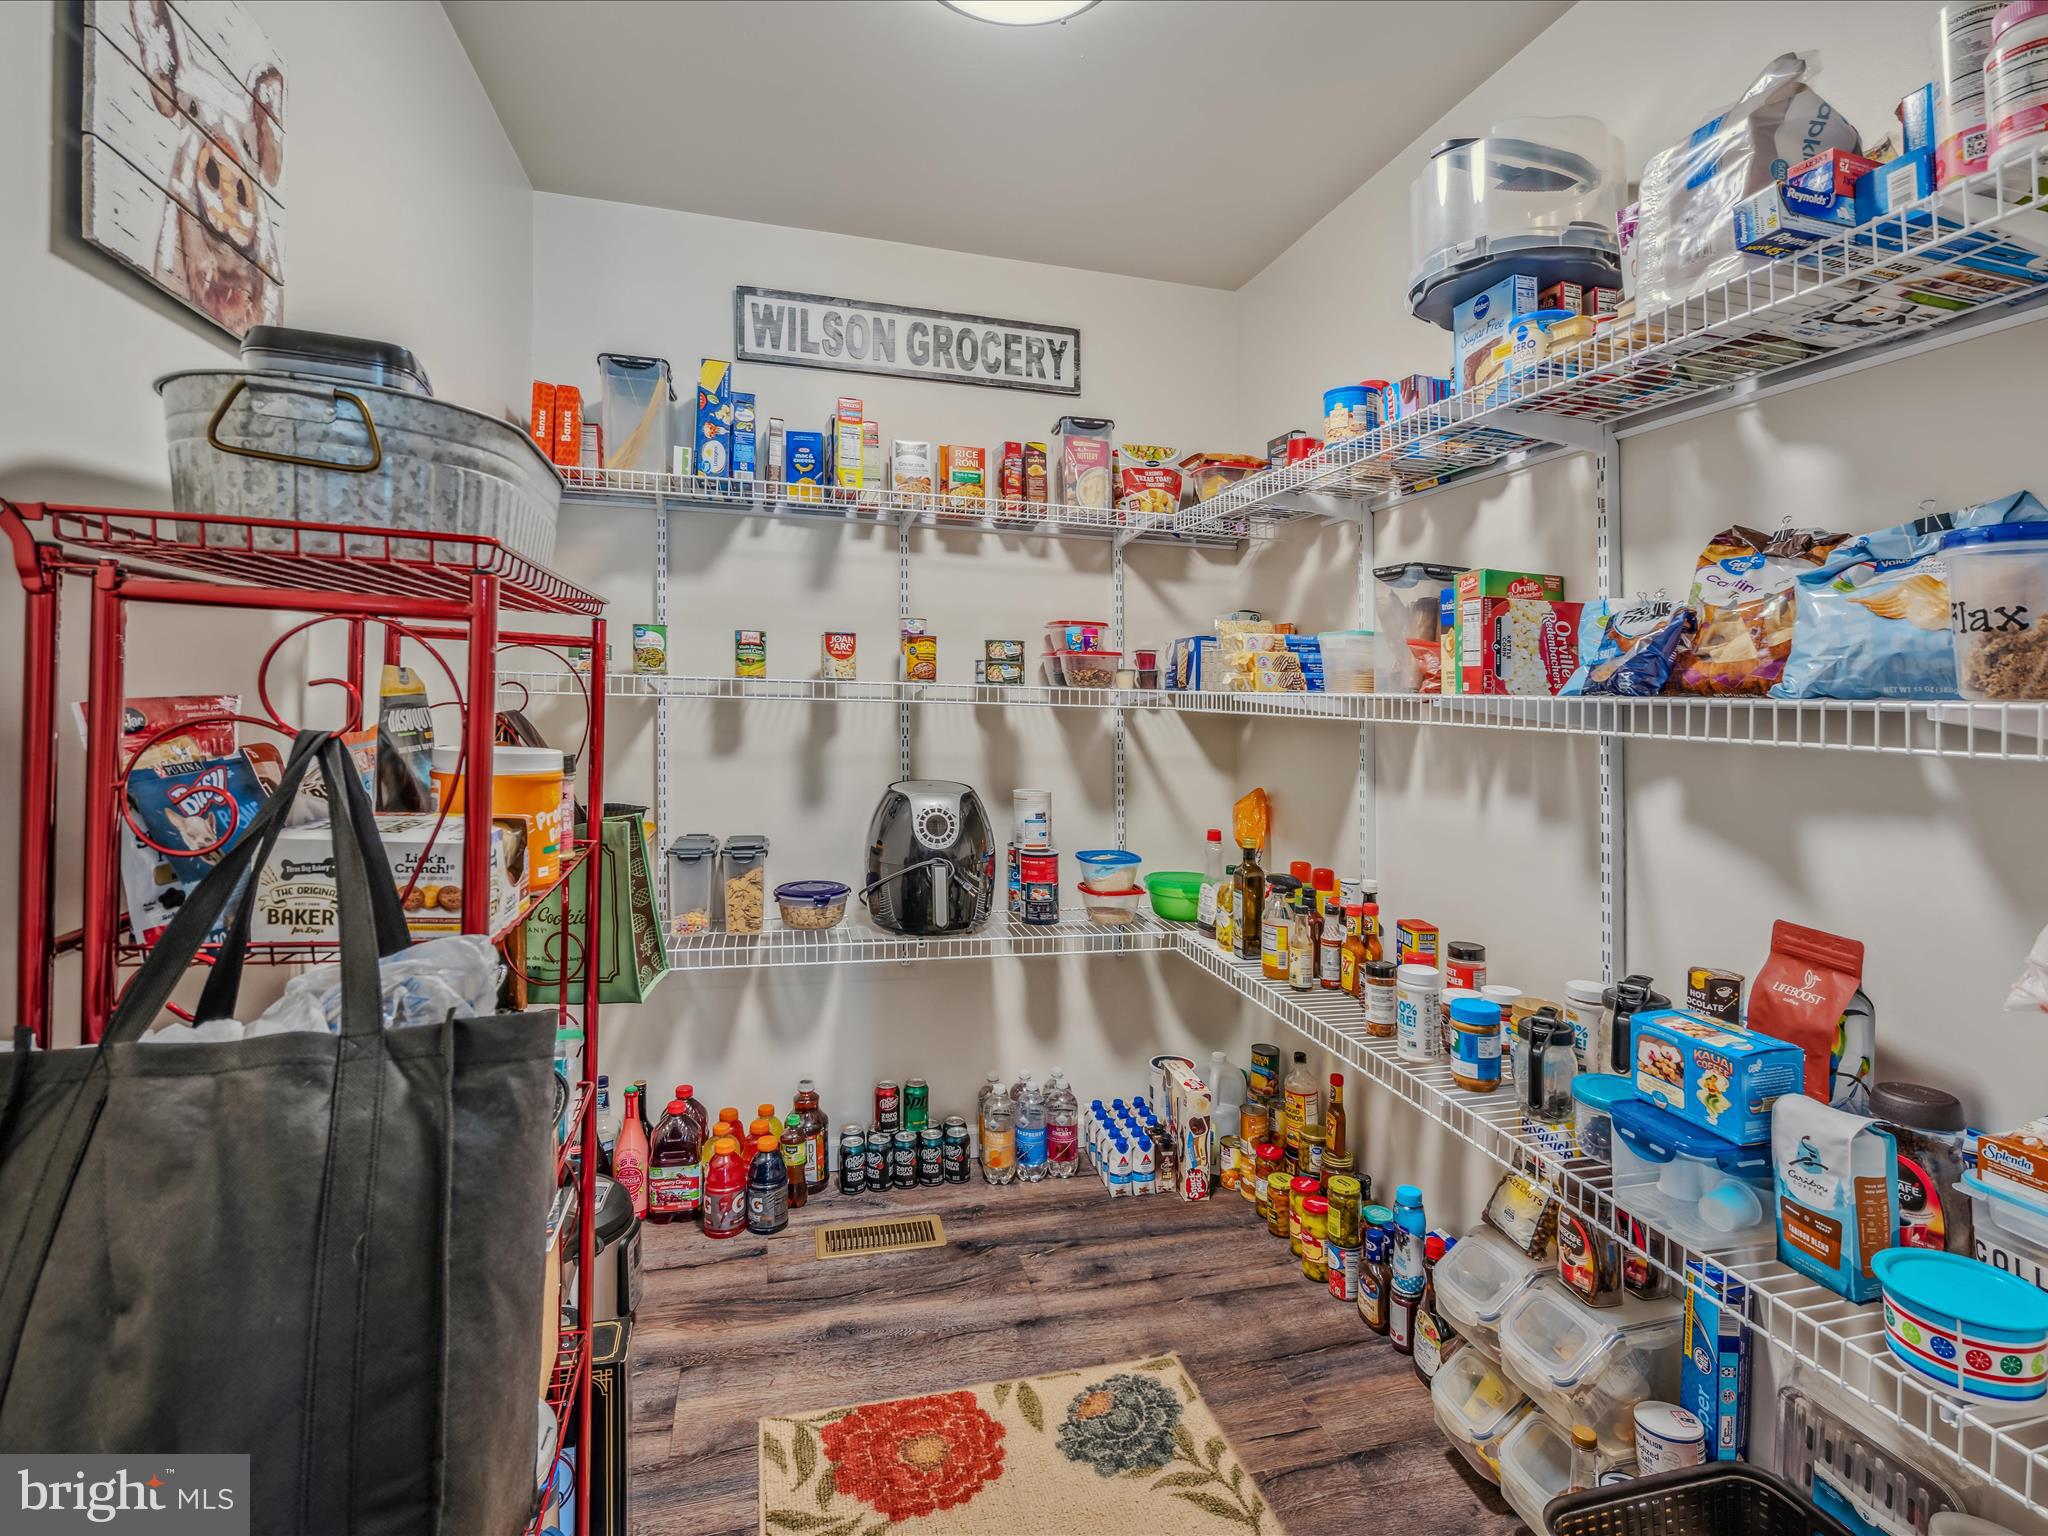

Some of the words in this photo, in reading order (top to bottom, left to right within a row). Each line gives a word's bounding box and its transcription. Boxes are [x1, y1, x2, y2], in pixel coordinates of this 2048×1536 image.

[1951, 3, 1997, 25] upplement
[1786, 187, 1830, 207] Reynolds
[750, 302, 896, 363] WILSON
[906, 321, 1069, 381] GROCERY
[1461, 326, 1486, 349] Sugar
[1486, 317, 1506, 336] Free
[1513, 339, 1537, 355] ZERO
[536, 409, 546, 438] Banza
[560, 410, 572, 442] Banza
[955, 449, 979, 459] RICE
[1511, 582, 1539, 594] Orville
[1706, 574, 1762, 593] Catin
[829, 635, 854, 645] JOAN
[834, 643, 853, 652] ARC
[1555, 620, 1575, 678] Orville
[1541, 611, 1563, 689] Redenbacher's
[164, 762, 203, 776] PURINA
[170, 768, 226, 817] Busy
[405, 853, 446, 864] Lik’n
[301, 865, 312, 873] Dog
[275, 886, 295, 898] THE
[296, 886, 337, 898] ORIGINA
[291, 926, 304, 935] for
[305, 926, 324, 935] Dogs
[1689, 988, 1707, 1000] HOT
[1772, 981, 1826, 1005] LIFEBOOST
[1399, 1000, 1418, 1016] 0%
[1686, 997, 1725, 1013] OCOLATE
[1399, 1013, 1417, 1028] RE!
[1693, 1048, 1734, 1076] KAUAI
[1695, 1059, 1730, 1079] COFFEE
[880, 1111, 898, 1119] zero
[1983, 1143, 2033, 1171] Splenda
[1189, 1173, 1199, 1199] Snack
[1787, 1169, 1829, 1194] Caribou
[731, 1191, 746, 1214] G
[751, 1197, 764, 1214] G
[1788, 1223, 1810, 1242] CARIBOU
[1810, 1235, 1830, 1254] BLEND
